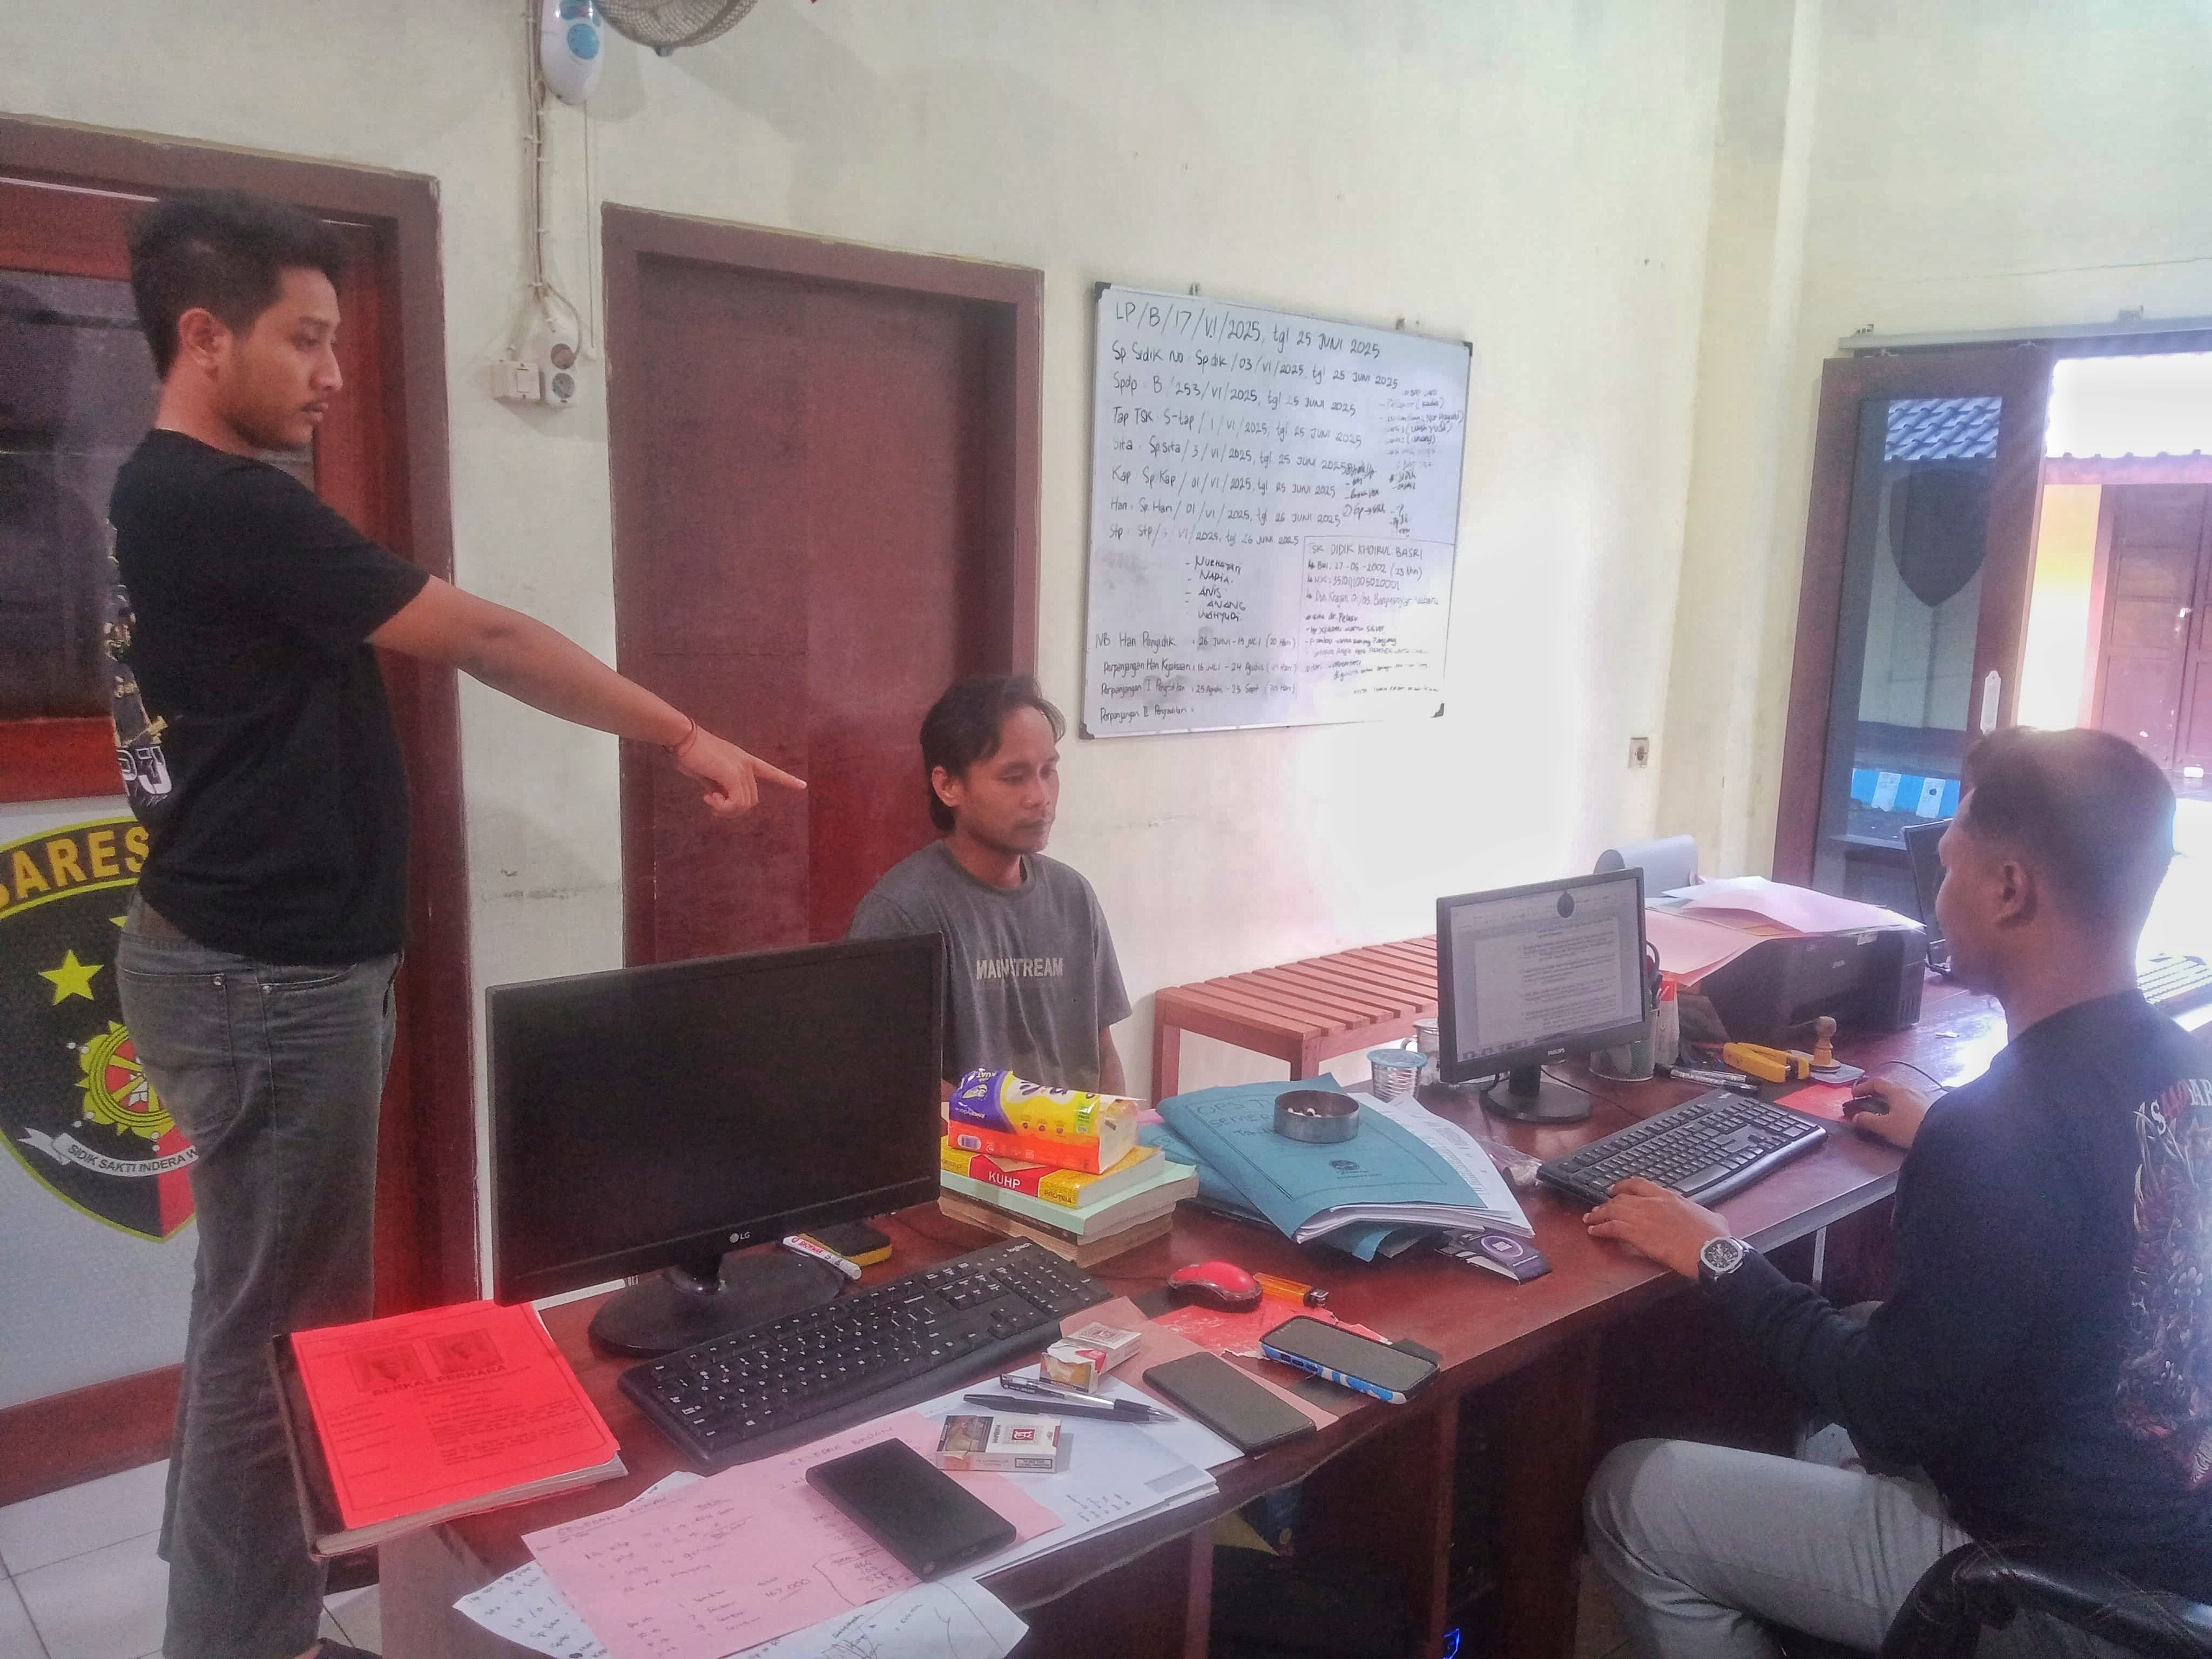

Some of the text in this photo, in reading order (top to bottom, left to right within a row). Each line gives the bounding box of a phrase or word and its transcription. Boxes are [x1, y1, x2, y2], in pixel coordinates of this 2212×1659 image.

[1273, 324, 1290, 353] tgl
[1296, 330, 1312, 346] 25
[1318, 332, 1344, 351] JUNI
[1350, 339, 1380, 359] 2025
[1332, 370, 1345, 381] 25
[1352, 372, 1370, 383] JUNI
[1374, 375, 1400, 389] 2025
[1305, 397, 1325, 408] JUNI
[1330, 402, 1356, 416] 2025
[1113, 406, 1129, 427] Tap
[1135, 407, 1154, 425] TSK
[1294, 426, 1305, 437] 25
[1310, 428, 1330, 439] JUNI
[1335, 431, 1362, 449] 2025
[1278, 454, 1291, 464] 25
[1296, 456, 1316, 467] JUNI
[1276, 482, 1286, 494] 25
[1291, 483, 1311, 494] JUNI
[1314, 485, 1336, 499] 2025
[1274, 512, 1286, 523] 26
[1291, 512, 1312, 523] JUNI
[1317, 514, 1341, 528] 2025
[1278, 535, 1300, 545] 2025
[1330, 543, 1354, 557] DIDIK
[1358, 544, 1392, 557] KHOIRUL
[1395, 547, 1424, 560] BASRI
[1206, 600, 1246, 611] ANANG
[1096, 632, 1111, 649] NB
[1119, 632, 1136, 648] Han
[1198, 636, 1209, 646] 26
[1213, 637, 1231, 647] JUNI
[1146, 657, 1159, 671] Han
[1197, 662, 1204, 671] 16
[1231, 662, 1242, 672] 24
[1195, 683, 1205, 693] 25
[1231, 685, 1242, 694] 23
[0, 826, 150, 912] ARES
[68, 1144, 98, 1166] SIDIK
[98, 1158, 136, 1173] SAKTI
[138, 1155, 186, 1172] INDERA
[988, 1170, 1021, 1189] KUHP
[739, 1232, 751, 1240] LG
[436, 1364, 508, 1383] PERKARA
